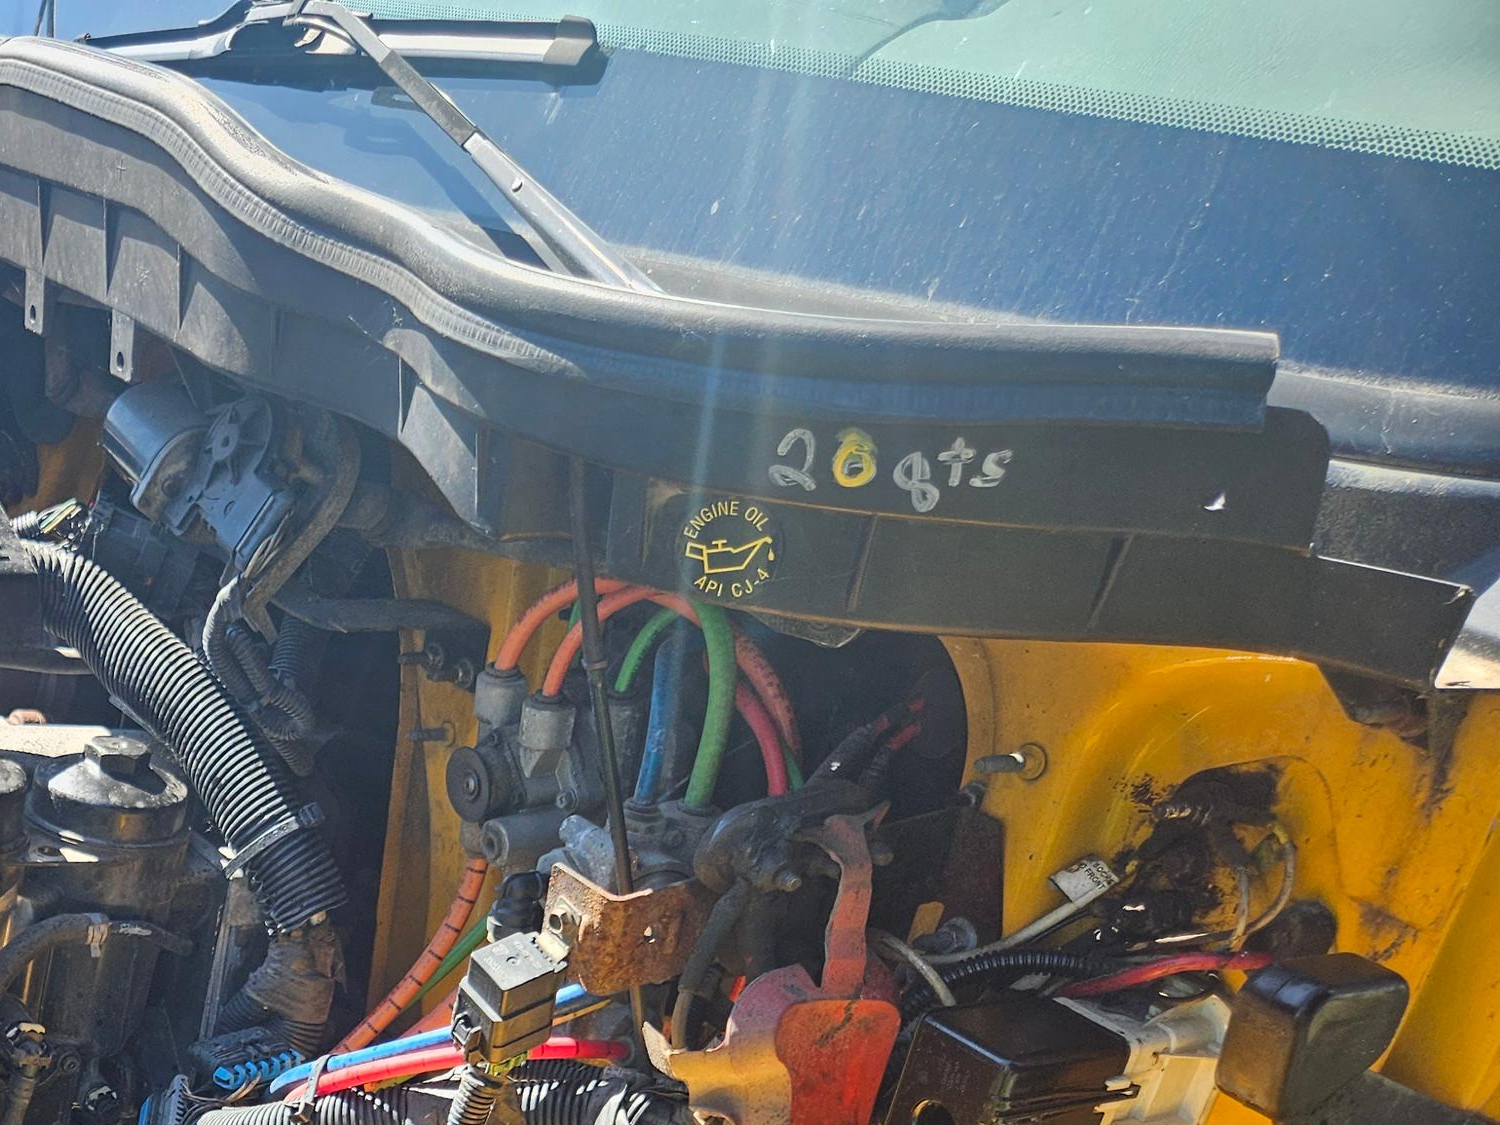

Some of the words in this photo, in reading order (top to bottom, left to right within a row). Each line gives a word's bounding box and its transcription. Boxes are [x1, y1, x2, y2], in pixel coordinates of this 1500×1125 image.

[683, 501, 740, 539] ENGINE
[744, 507, 769, 531] OIL
[694, 576, 723, 597] API
[731, 568, 769, 597] CJ-4
[1085, 868, 1106, 890] FRONT
